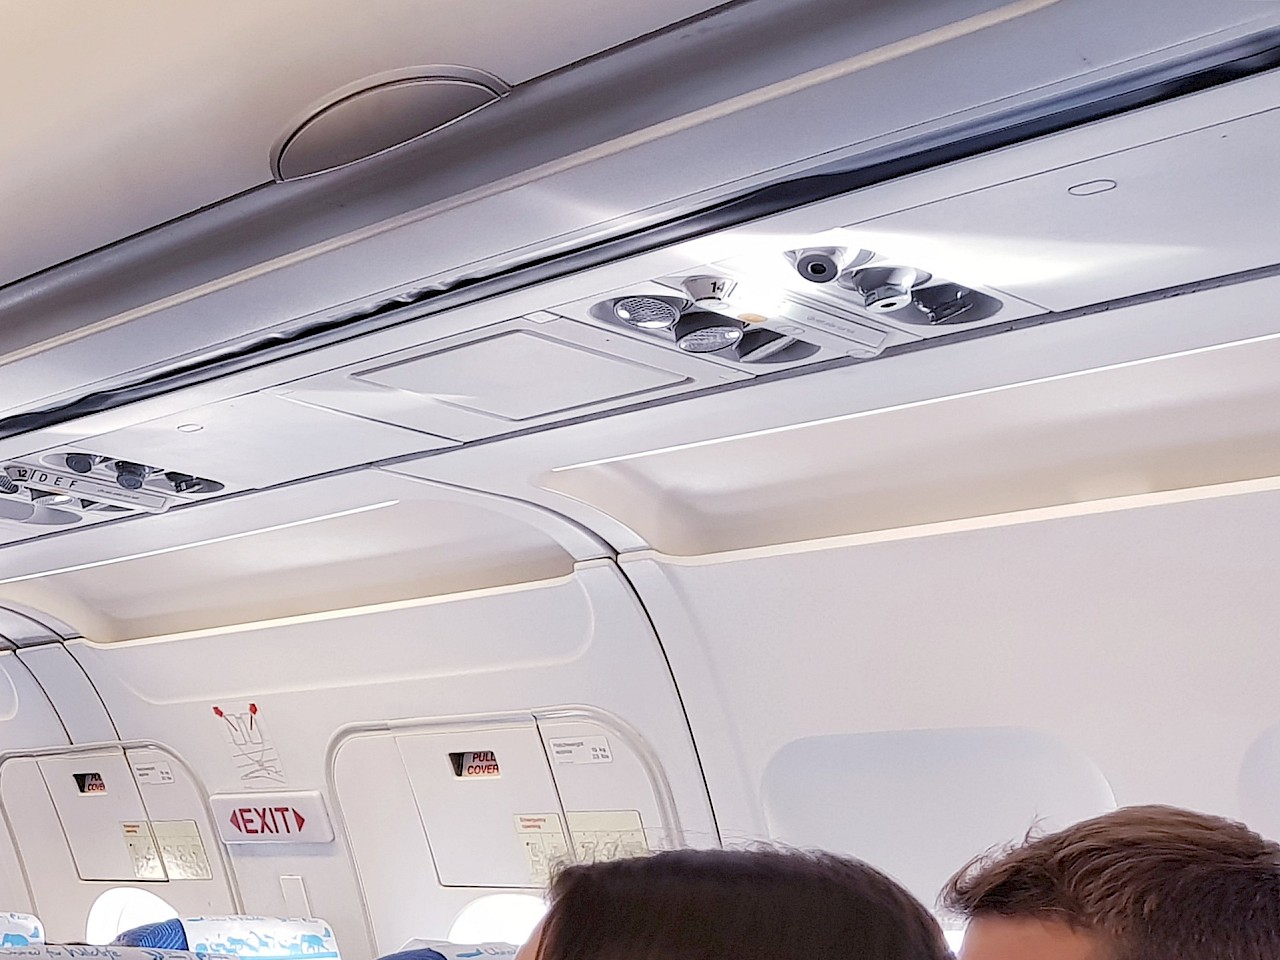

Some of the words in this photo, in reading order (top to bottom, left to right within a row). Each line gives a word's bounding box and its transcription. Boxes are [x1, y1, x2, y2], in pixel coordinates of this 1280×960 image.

[710, 281, 726, 293] 14
[16, 469, 28, 478] 12
[38, 473, 48, 482] D
[54, 476, 63, 486] E
[69, 480, 78, 488] F
[472, 751, 497, 763] PULL
[467, 764, 499, 775] COVER
[238, 807, 291, 834] EXIT
